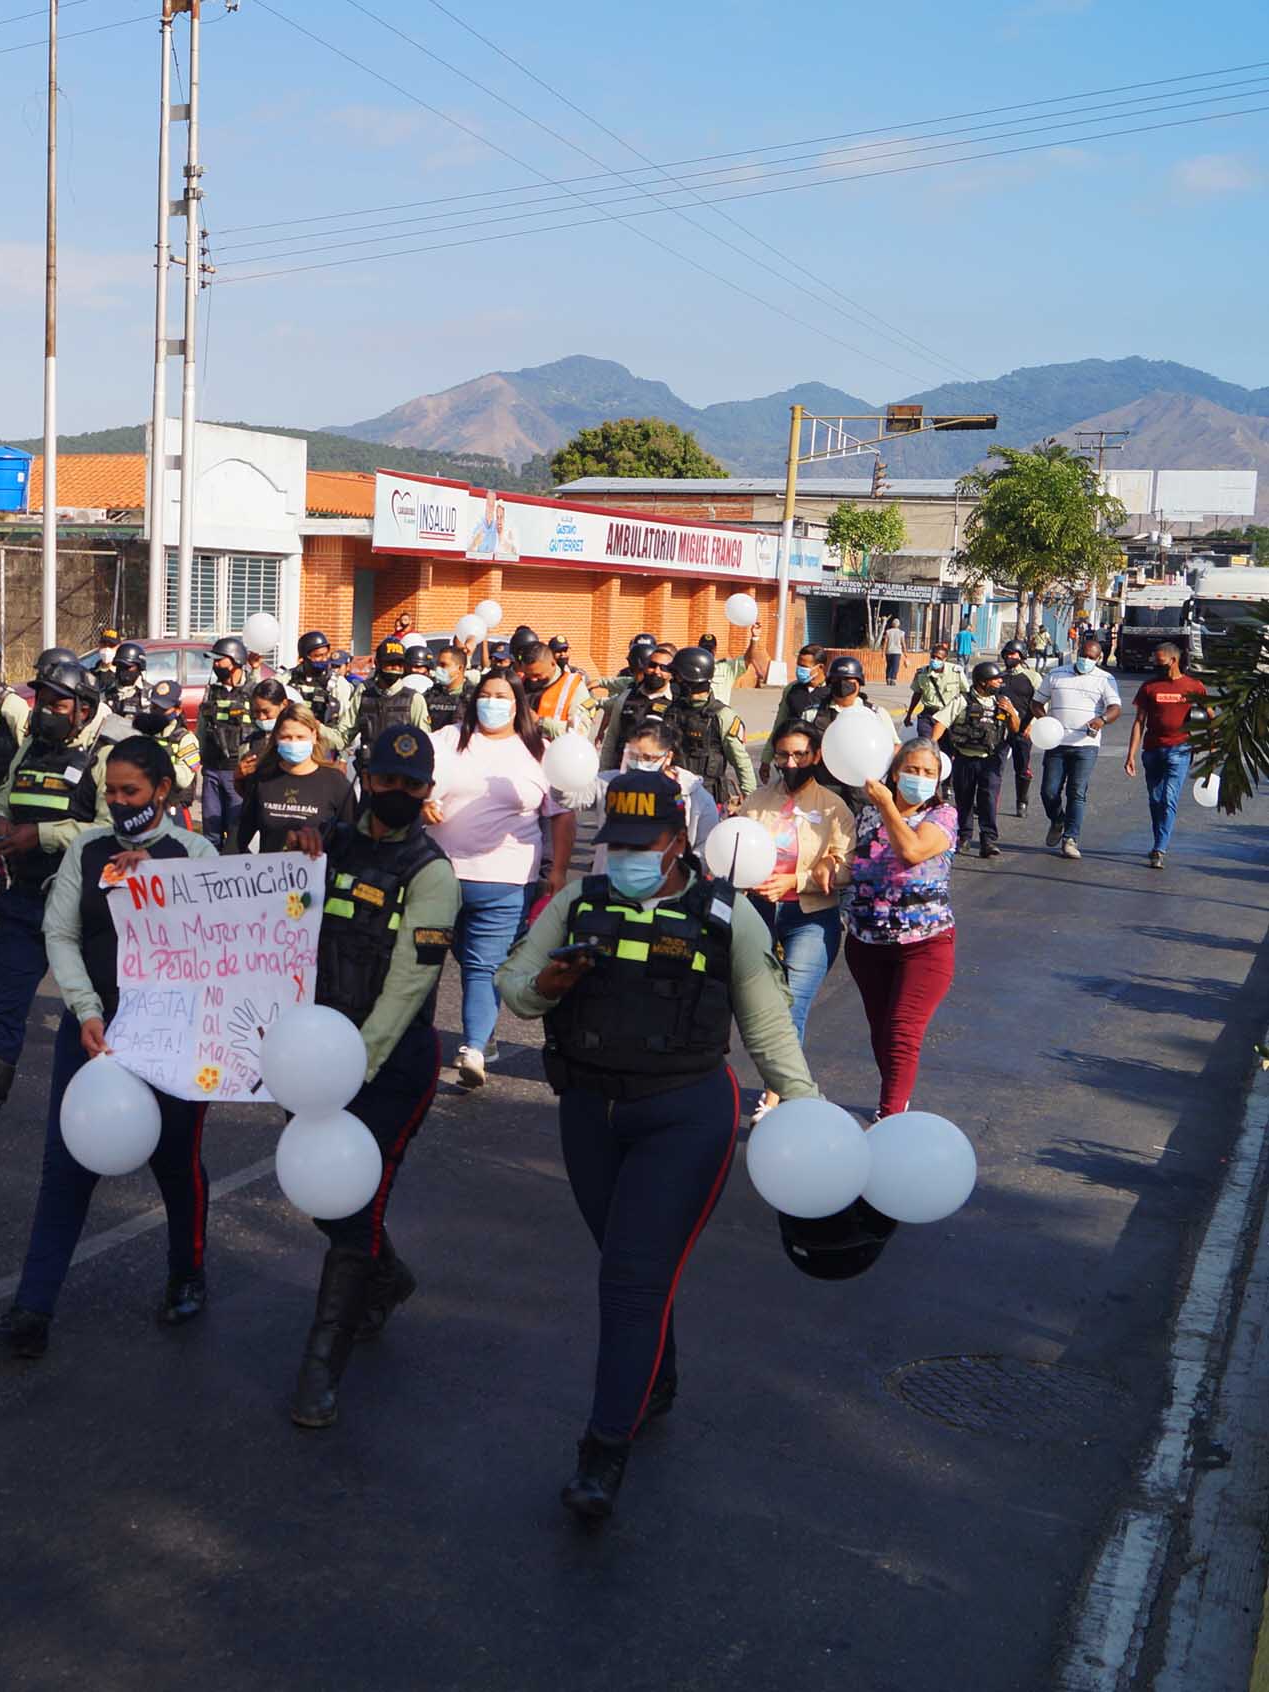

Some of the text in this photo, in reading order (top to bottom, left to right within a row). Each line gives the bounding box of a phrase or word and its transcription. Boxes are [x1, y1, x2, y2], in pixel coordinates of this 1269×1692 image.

[419, 503, 457, 532] INSALUD
[605, 522, 742, 568] AMBULATORIO MIGUEL FRANCO
[123, 806, 154, 831] PMN
[607, 791, 656, 817] PMN
[126, 875, 166, 910] NO
[172, 872, 199, 904] AL
[125, 918, 140, 947] A
[145, 918, 171, 947] La
[246, 912, 268, 945] ni
[216, 945, 239, 977] de
[245, 951, 281, 976] una
[203, 985, 224, 1008] NO
